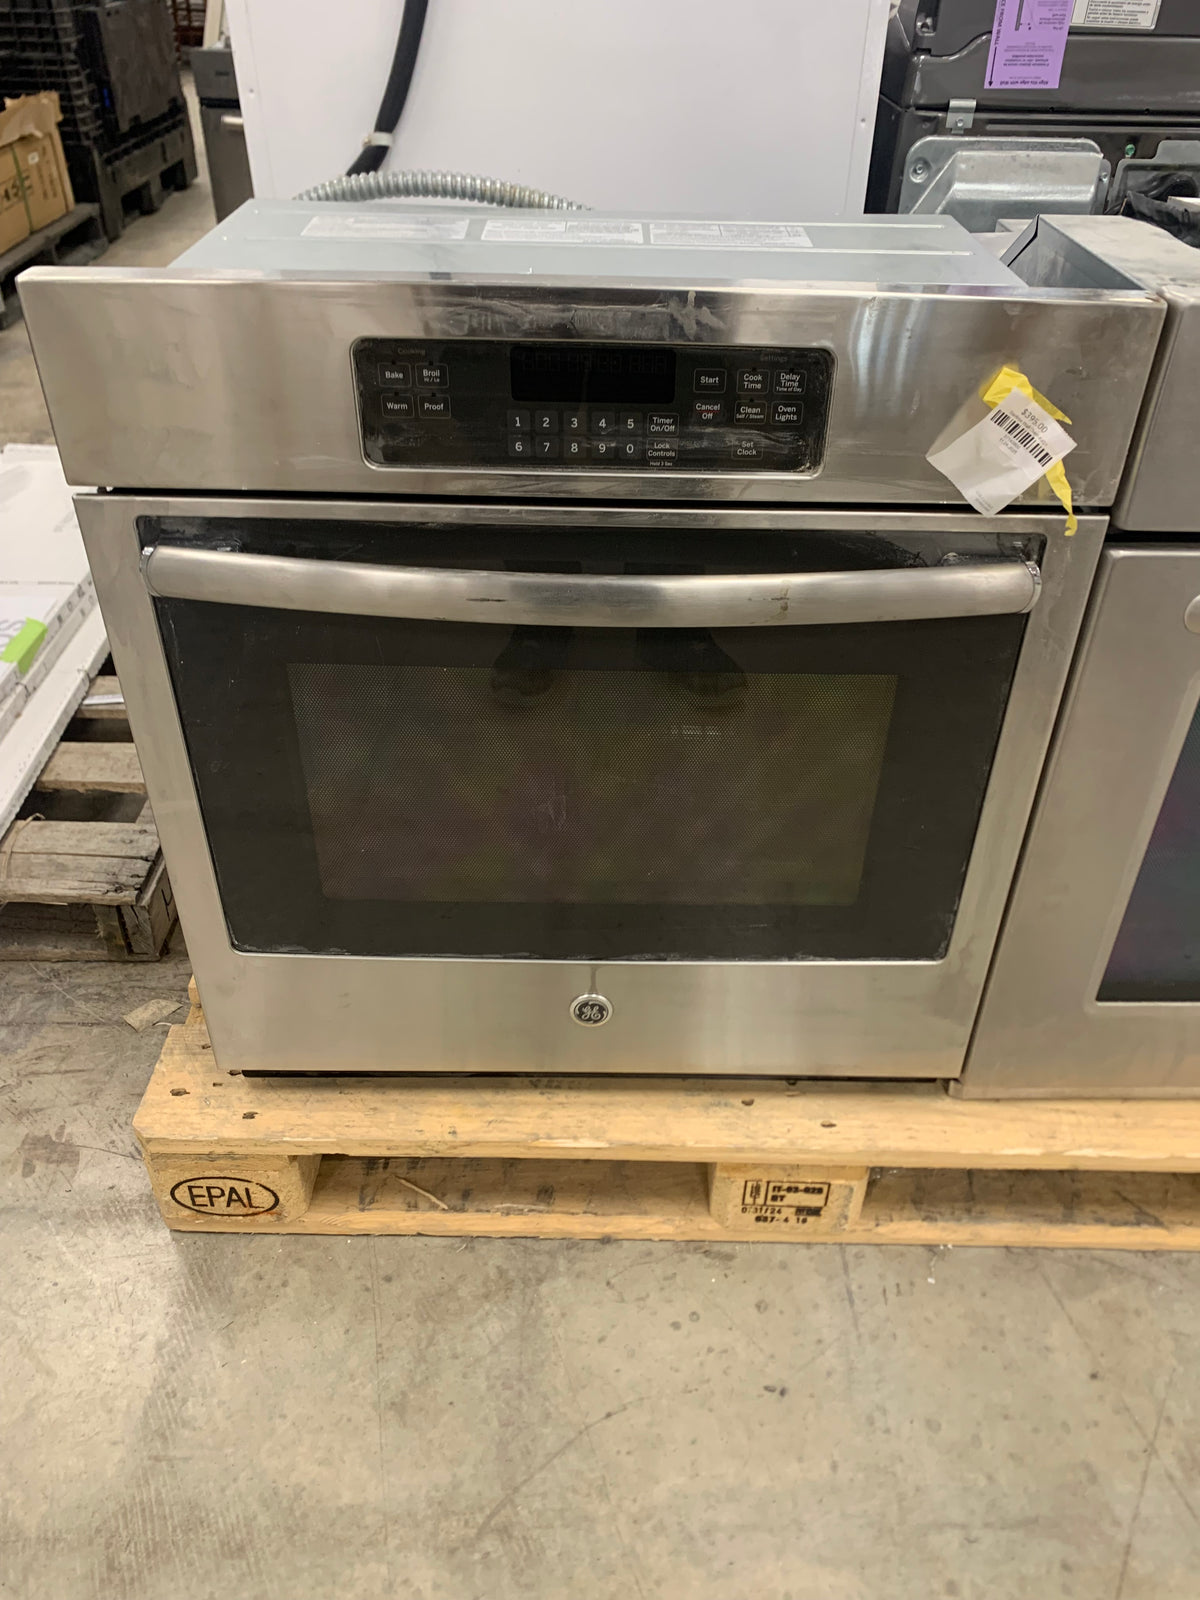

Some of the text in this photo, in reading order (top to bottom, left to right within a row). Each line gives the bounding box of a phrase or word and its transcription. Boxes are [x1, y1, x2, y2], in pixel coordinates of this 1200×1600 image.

[384, 371, 404, 380] Bake
[422, 369, 441, 378] Broil
[743, 373, 763, 381] Cook
[779, 372, 801, 382] Delay
[700, 375, 719, 384] Start
[780, 380, 799, 388] Time
[386, 402, 408, 410] Warm
[423, 402, 444, 411] Proof
[695, 403, 721, 411] Cancel
[740, 406, 761, 414] Clean
[777, 405, 797, 413] Oven
[652, 416, 674, 424] Timer
[701, 412, 714, 420] Off
[775, 413, 798, 422] Lights
[1021, 408, 1049, 433] $395.00
[515, 417, 635, 429] 1 2 3 4 5
[650, 424, 675, 433] On/Off
[515, 442, 634, 454] 6 7 8 9 0
[741, 441, 754, 449] Set
[737, 448, 757, 456] Clock
[187, 1185, 265, 1209] EPAL
